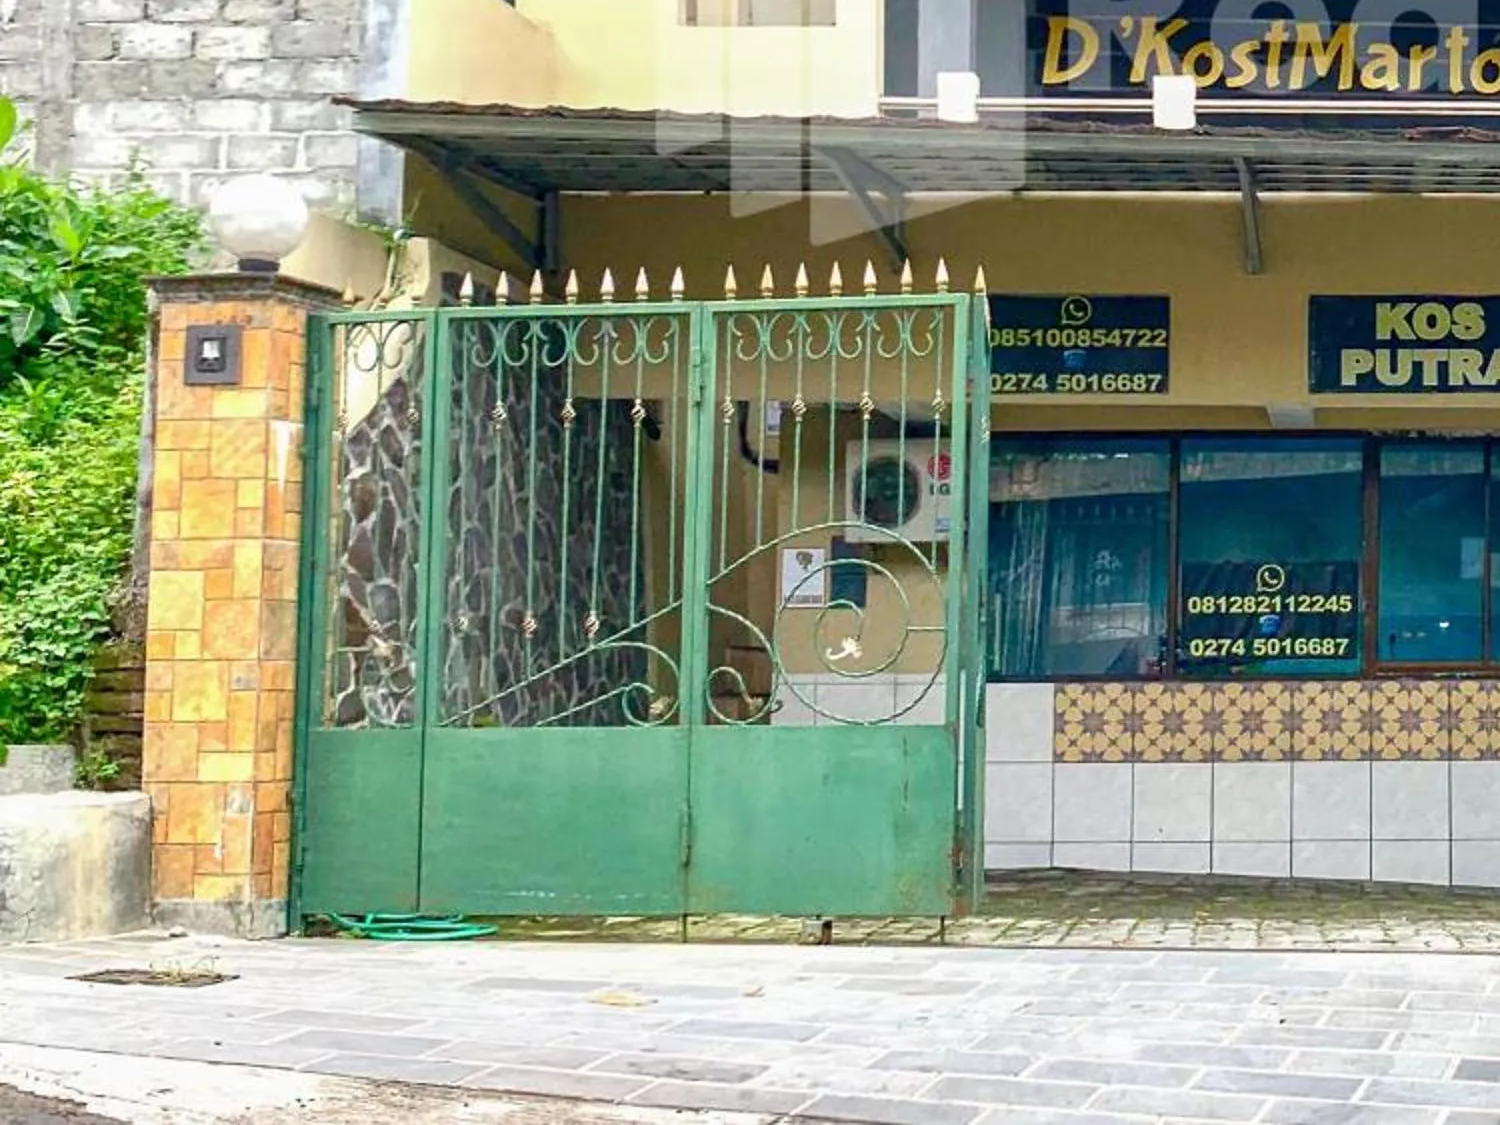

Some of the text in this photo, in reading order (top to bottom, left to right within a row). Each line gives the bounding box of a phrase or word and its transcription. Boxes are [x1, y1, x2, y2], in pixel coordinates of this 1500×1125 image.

[1375, 302, 1487, 340] KOS
[990, 327, 1167, 348] 085100854722
[990, 373, 1163, 392] 0274 5016687
[1187, 594, 1353, 615] 081282112245
[1190, 638, 1349, 657] 0274 5016687
